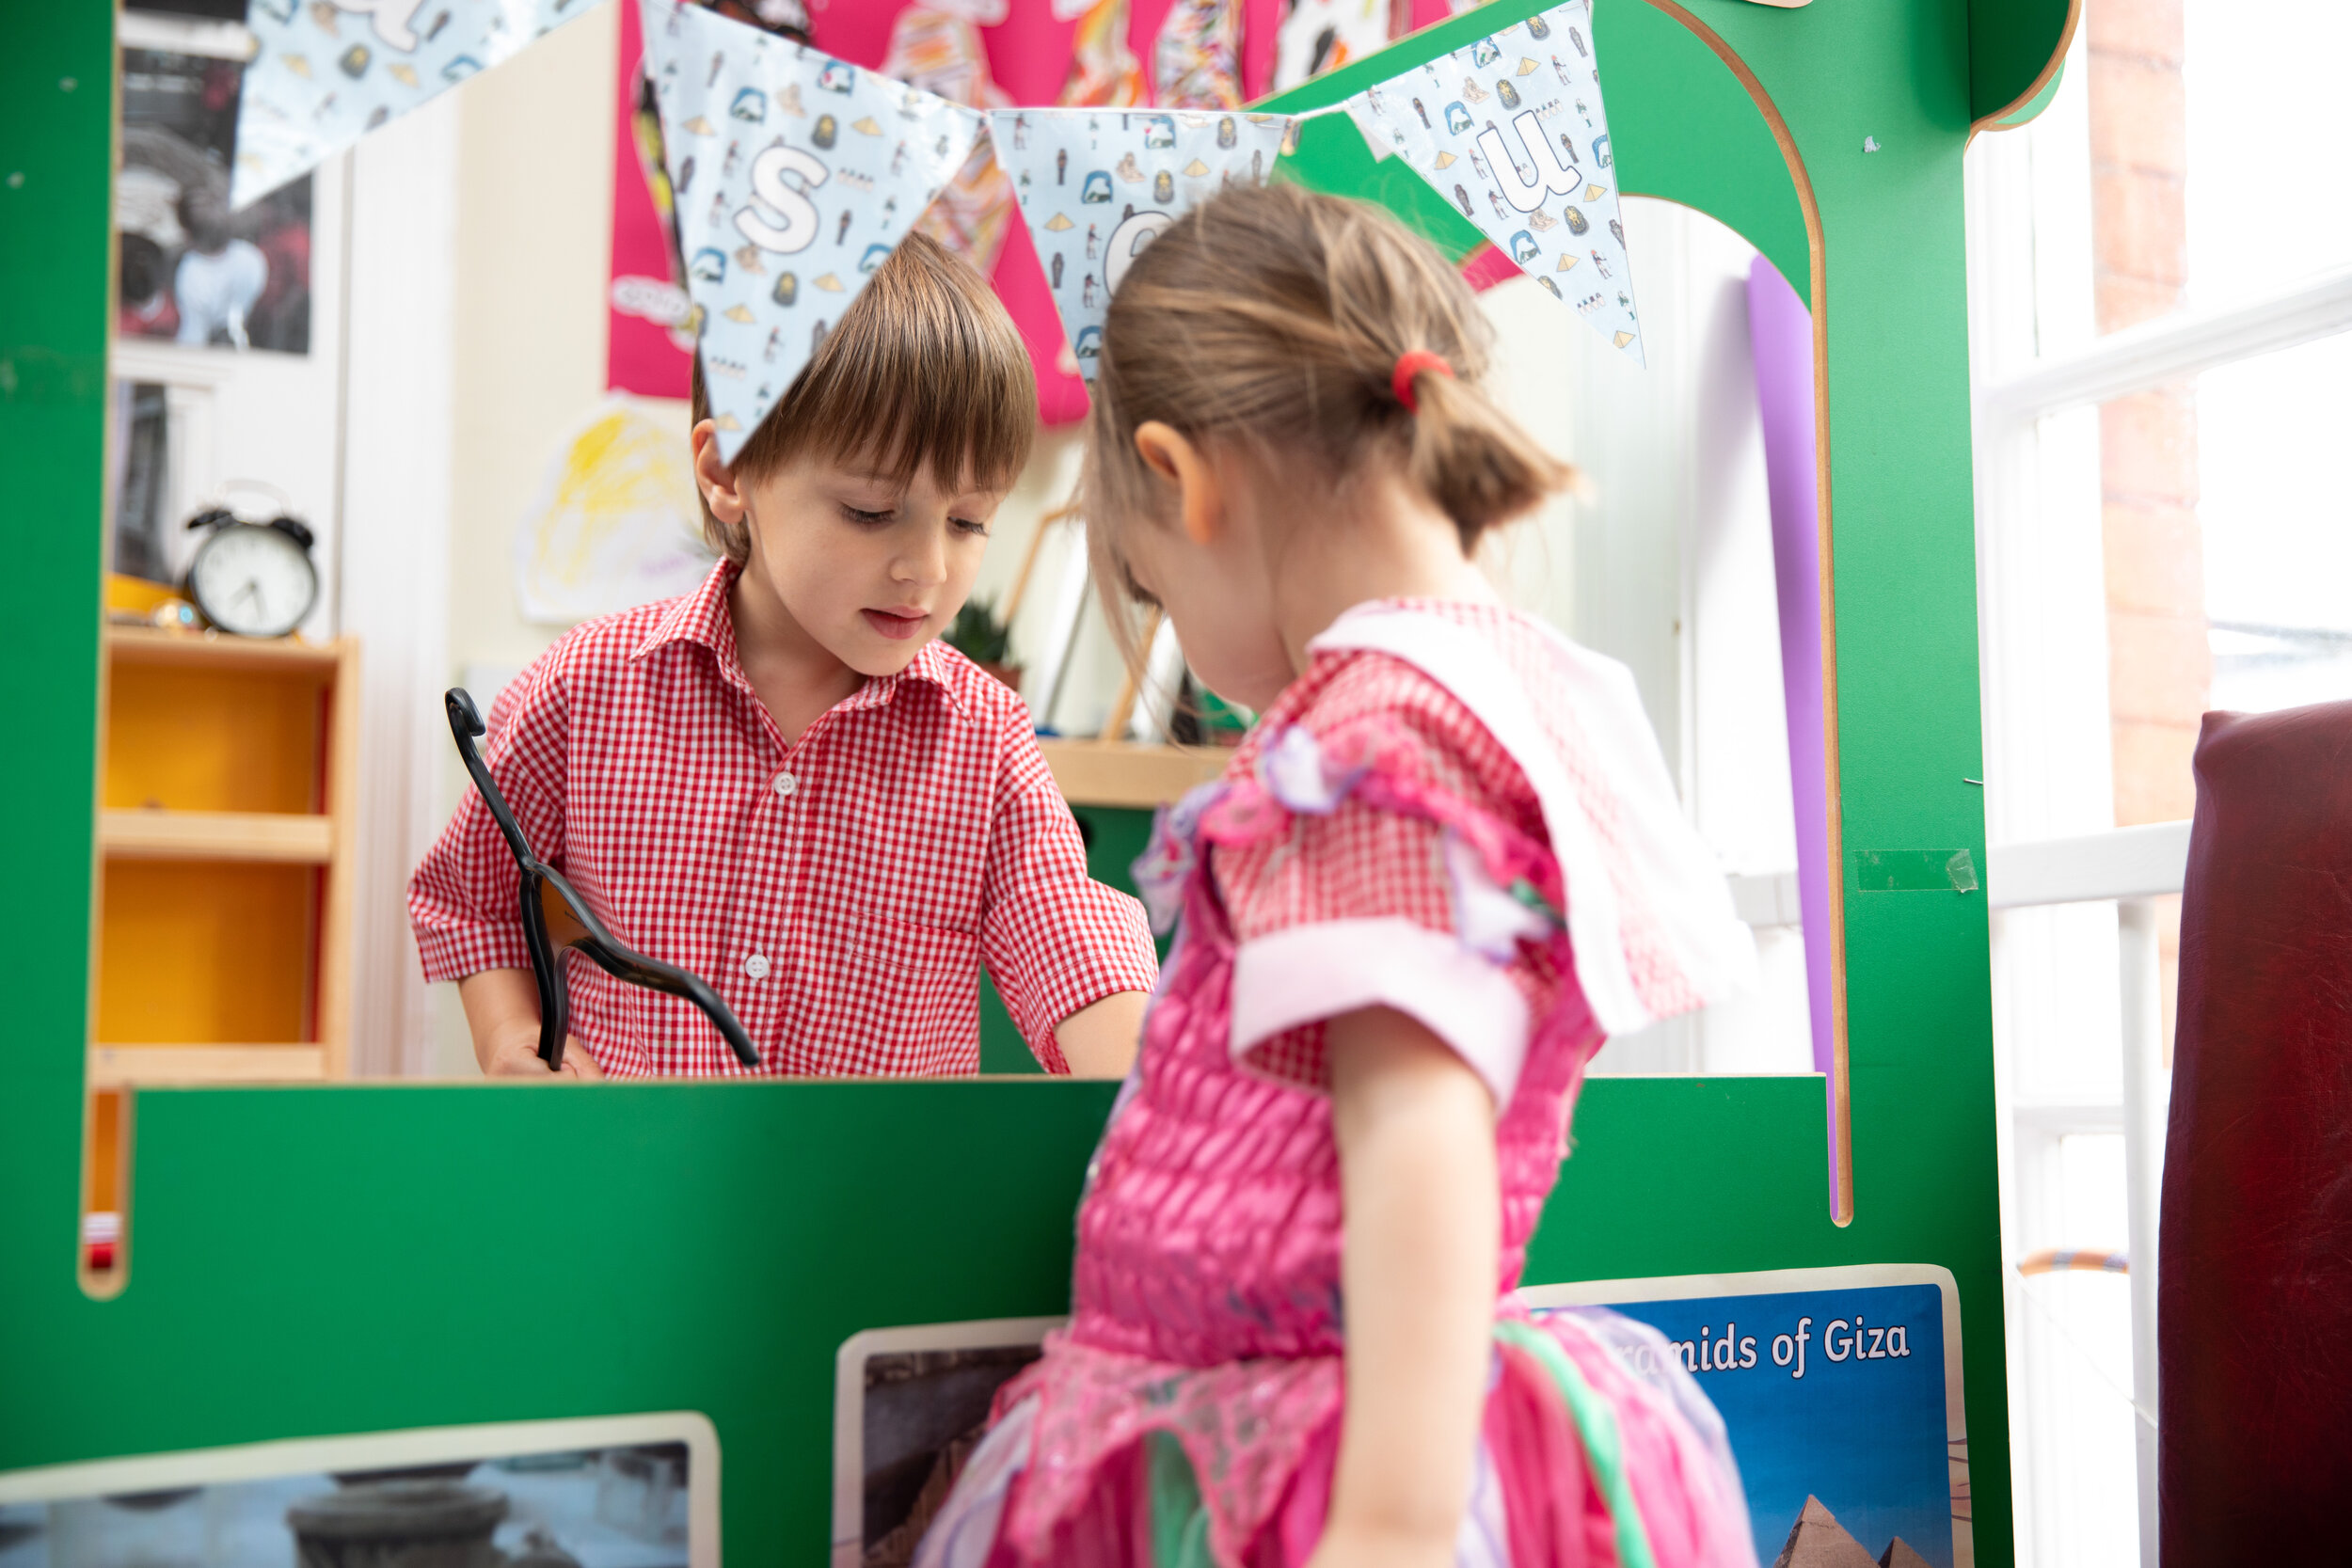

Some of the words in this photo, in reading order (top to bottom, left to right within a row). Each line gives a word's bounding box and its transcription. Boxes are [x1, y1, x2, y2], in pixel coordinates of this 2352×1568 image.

[1476, 109, 1582, 214] u
[1771, 1317, 1813, 1379] of
[1823, 1316, 1911, 1362] Giza
